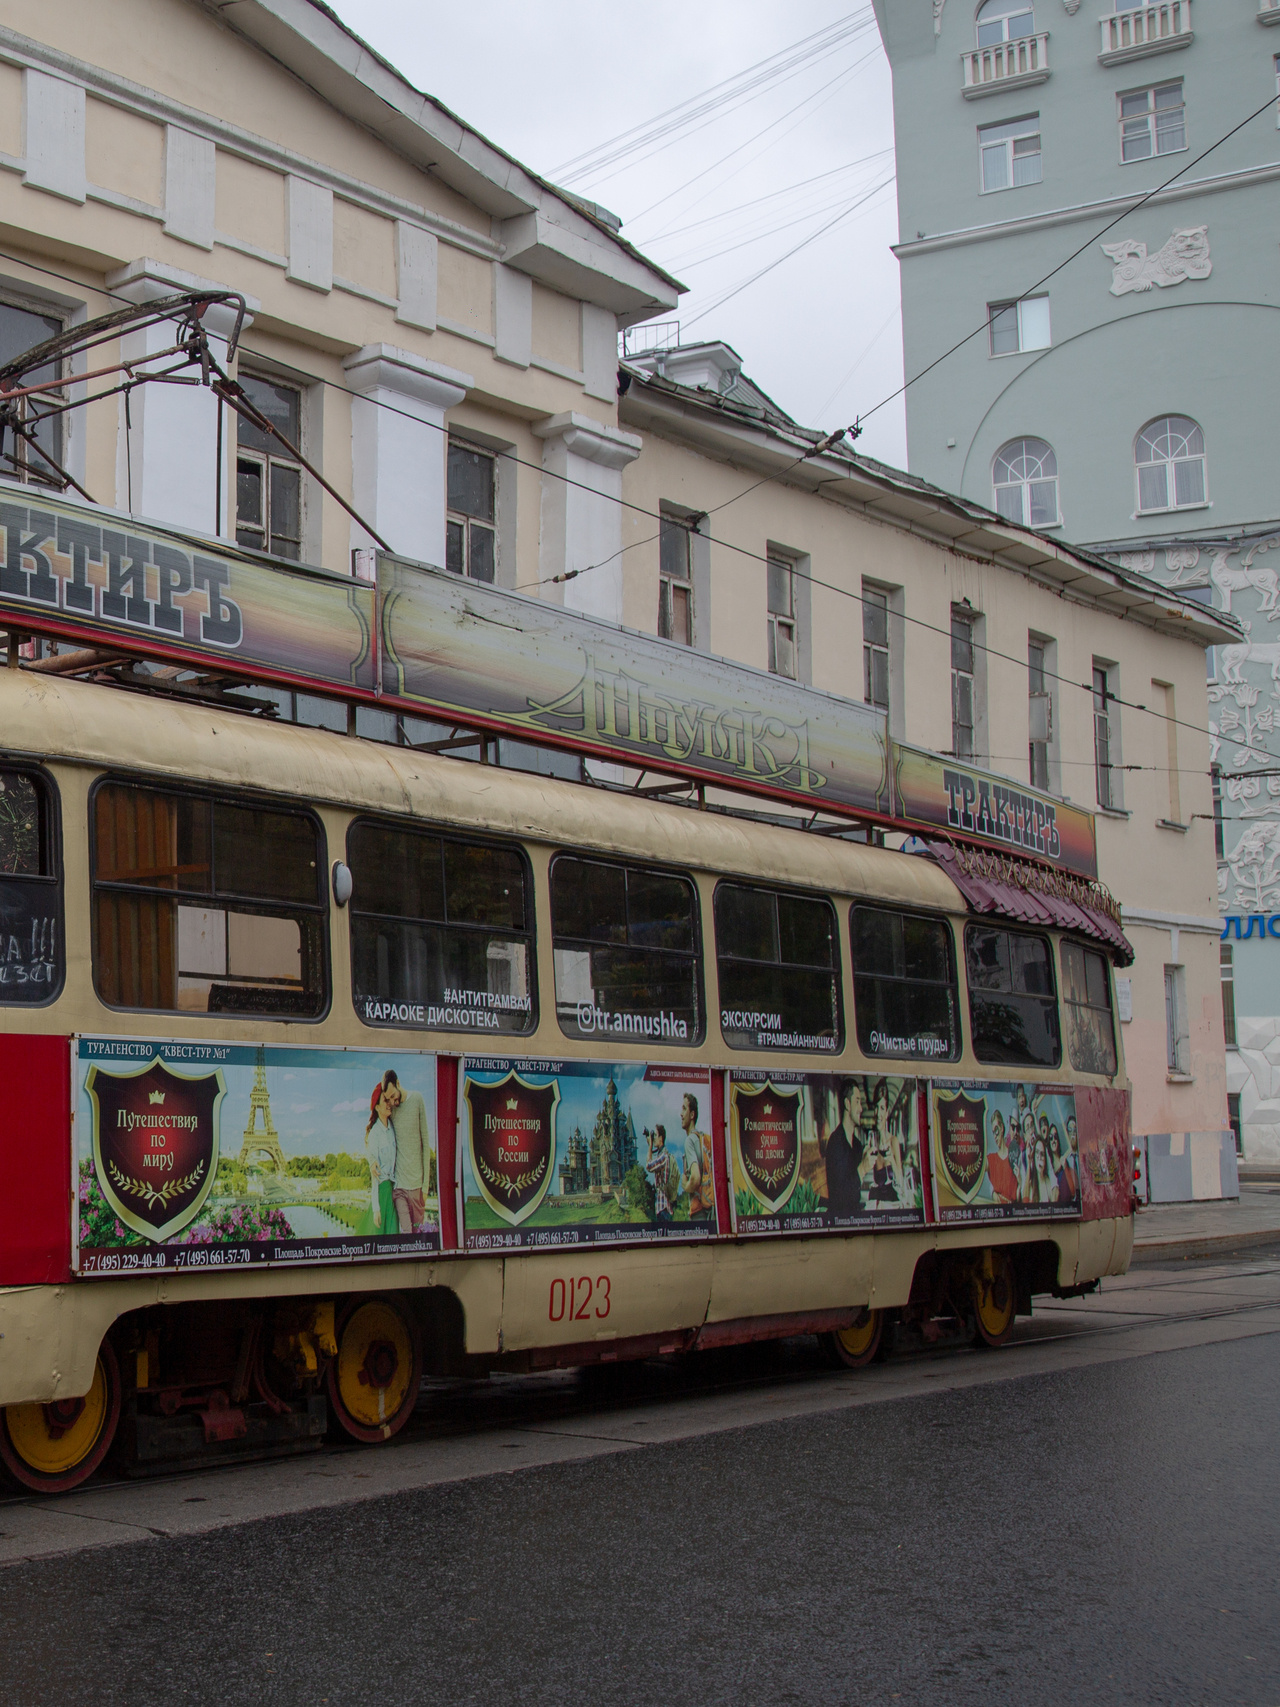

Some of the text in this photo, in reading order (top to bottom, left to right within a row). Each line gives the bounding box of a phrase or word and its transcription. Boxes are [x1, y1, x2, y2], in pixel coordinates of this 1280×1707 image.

[943, 767, 1060, 859] ТРАКТИРЪ
[443, 987, 532, 1012] #АНТИТРАМВАЙ
[365, 1002, 500, 1029] КАРАОКЕ ДИСКОТЕКА
[721, 1010, 782, 1030] ЭКСКУРСИИ
[87, 1042, 152, 1056] ТУРАГЕНСТВО
[757, 1031, 836, 1051] #ТРАМВАЙАННУШКА
[879, 1033, 948, 1056] Чистые пруды
[465, 1058, 509, 1069] ТУРАГЕНСТВО
[117, 1109, 198, 1132] Путешествия
[484, 1113, 541, 1134] Путешествия
[150, 1135, 166, 1147] по
[507, 1135, 519, 1146] по
[142, 1152, 174, 1171] миру
[498, 1147, 529, 1163] России
[475, 1234, 491, 1249] (495)
[535, 1231, 550, 1245] (495)
[83, 1249, 251, 1271] +7 (495) 229-40-40 +7 (495) 661-57-70
[549, 1275, 611, 1321] 0123
